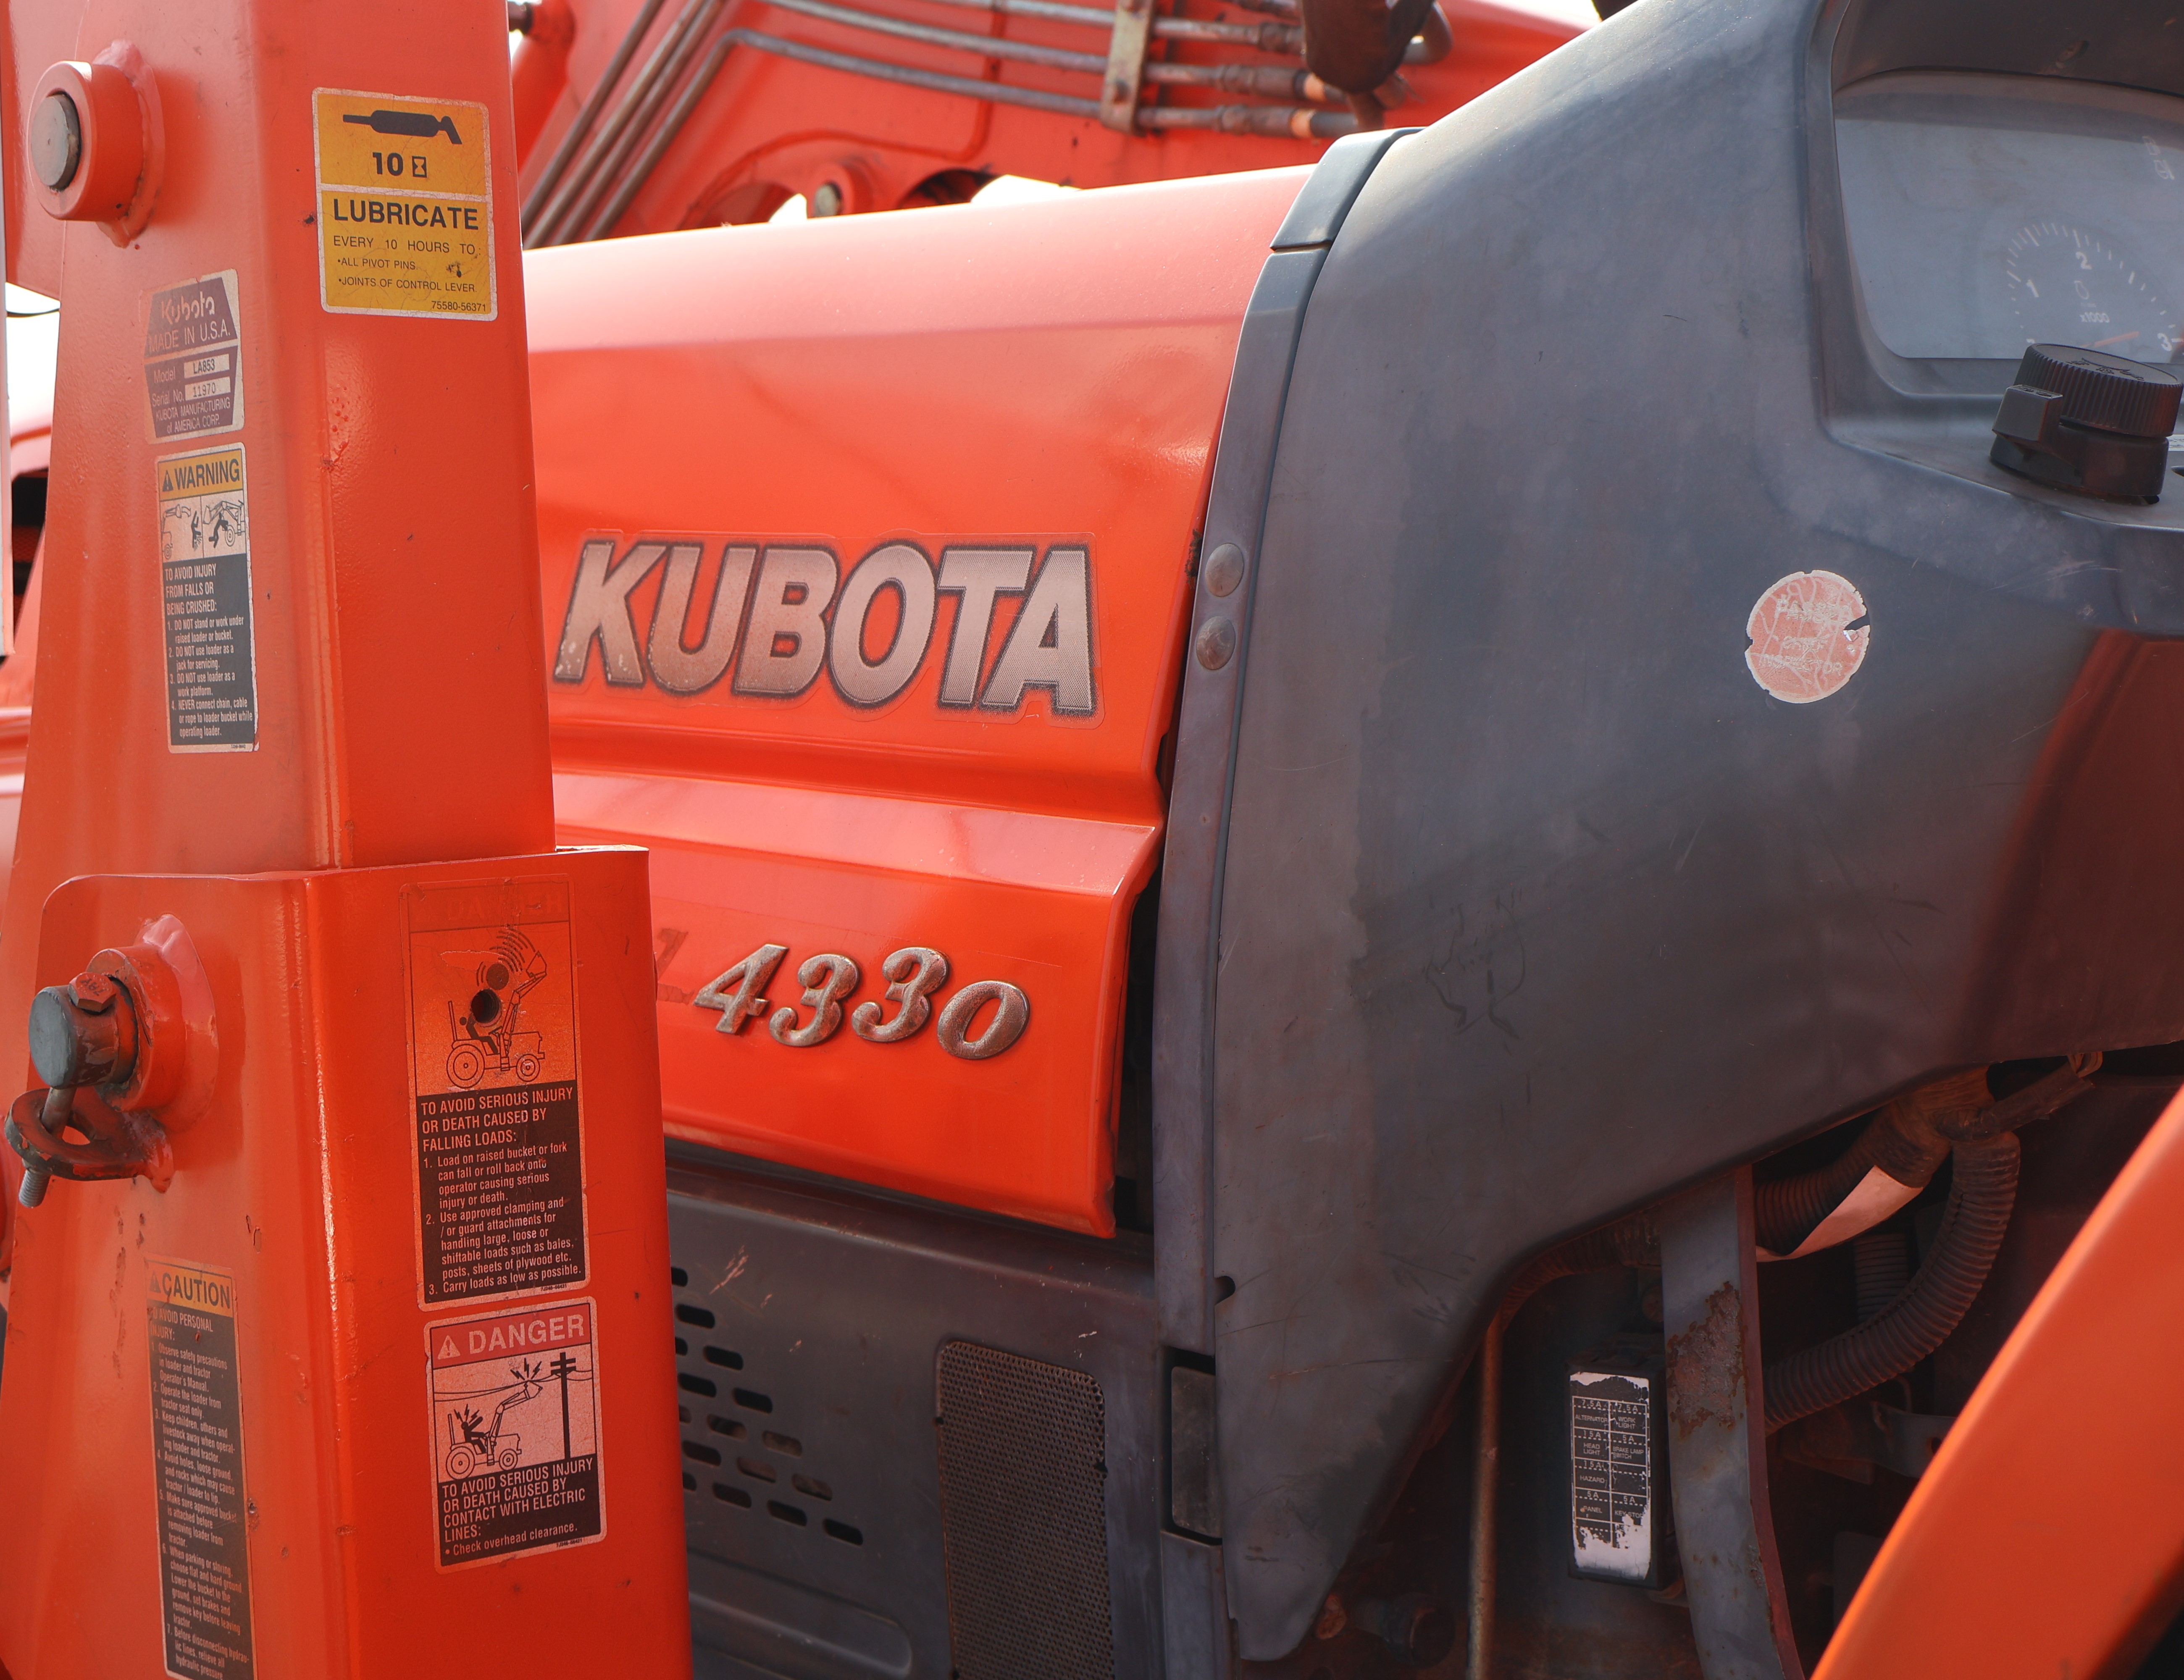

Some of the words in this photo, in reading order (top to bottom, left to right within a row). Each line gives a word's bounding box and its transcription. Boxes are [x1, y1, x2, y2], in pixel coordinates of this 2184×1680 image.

[373, 152, 403, 176] 10
[334, 199, 478, 230] LUBRICATE
[334, 236, 373, 247] EVERY
[385, 240, 397, 249] 10
[408, 241, 450, 252] HOURS
[363, 259, 390, 268] PIVOT
[394, 261, 418, 270] PINS.
[2076, 251, 2092, 270] 2
[342, 278, 376, 286] JOINTS
[381, 279, 393, 287] OF
[397, 280, 442, 291] CONTROL
[445, 283, 477, 292] LEVER.
[2026, 279, 2039, 297] 1
[161, 291, 215, 324] Kubota
[431, 301, 486, 312] 75580-56371
[149, 330, 179, 352] MADE
[184, 326, 194, 345] IN
[200, 319, 230, 341] U.S.A.
[2157, 333, 2172, 352] 3
[154, 367, 175, 383] Model
[193, 359, 215, 374] LA853
[152, 393, 170, 407] Serial
[173, 389, 184, 403] No.
[193, 383, 216, 397] 11970
[156, 407, 178, 421] KUBOTA
[181, 397, 230, 417] MANUFACTURING
[168, 422, 172, 433] of
[174, 418, 200, 433] AMERICA
[202, 414, 220, 427] CORP.
[174, 459, 239, 490] WARNING
[165, 568, 173, 581] TO
[175, 566, 192, 580] AVOID
[194, 563, 216, 578] INJURY
[166, 585, 183, 598] FROM
[185, 583, 203, 597] FALLS
[205, 582, 214, 594] OR
[167, 602, 184, 615] BEING
[186, 599, 217, 614] CRUSHED:
[175, 620, 181, 630] DO
[183, 619, 193, 630] NOT
[194, 617, 208, 629] stand
[216, 616, 228, 627] work
[229, 615, 244, 626] under
[552, 536, 1099, 718] KUBOTA
[175, 633, 190, 643] raised
[192, 632, 207, 643] loader
[215, 630, 233, 640] bucket.
[693, 943, 1031, 1061] 4330
[421, 1102, 436, 1116] TO
[440, 1097, 475, 1113] AVOID
[479, 1092, 528, 1109] SERIOUS
[533, 1087, 573, 1104] INJURY
[422, 1121, 439, 1134] OR
[443, 1115, 479, 1131] DEATH
[484, 1110, 528, 1127] CAUSED
[533, 1108, 547, 1121] BY
[423, 1135, 471, 1152] FALLING
[475, 1129, 516, 1146] LOADS:
[423, 1158, 432, 1168] 1.
[438, 1155, 460, 1167] Load
[463, 1155, 473, 1164] on
[477, 1149, 504, 1161] raised
[507, 1145, 536, 1159] bucket
[539, 1145, 548, 1154] or
[550, 1142, 567, 1154] fork
[438, 1171, 454, 1181] can
[457, 1167, 471, 1179] fall
[475, 1168, 484, 1177] or
[487, 1163, 501, 1175] roll
[505, 1161, 525, 1173] back
[528, 1159, 547, 1170] onto
[439, 1181, 477, 1197] operator
[480, 1177, 514, 1189] causing
[517, 1173, 549, 1186] serious
[426, 1215, 434, 1225] 2.
[440, 1212, 457, 1223] Use
[460, 1205, 501, 1222] approved
[505, 1200, 545, 1214] clamping
[548, 1197, 564, 1209] and
[439, 1198, 465, 1210] injury
[468, 1196, 477, 1205] or
[480, 1191, 508, 1204] death.
[447, 1227, 455, 1236] or
[459, 1222, 484, 1236] guard
[487, 1214, 541, 1231] attachments
[544, 1213, 556, 1223] for
[442, 1237, 480, 1251] handling
[484, 1234, 509, 1246] large,
[513, 1230, 536, 1241] loose
[540, 1228, 548, 1237] or
[442, 1250, 481, 1265] shiftable
[484, 1247, 508, 1259] loads
[511, 1244, 531, 1255] such
[534, 1243, 544, 1251] as
[547, 1238, 574, 1250] bales,
[443, 1267, 470, 1281] posts,
[473, 1262, 502, 1274] sheets
[505, 1259, 513, 1270] of
[516, 1252, 552, 1270] plywood
[555, 1252, 571, 1263] etc.
[162, 1273, 230, 1309] CAUTION
[429, 1284, 437, 1295] 3.
[443, 1281, 467, 1293] Carry
[470, 1277, 494, 1289] loads
[497, 1276, 507, 1285] as
[510, 1272, 526, 1283] low
[528, 1272, 539, 1280] as
[541, 1265, 581, 1281] possible.
[160, 1309, 178, 1324] AVOID
[180, 1313, 213, 1332] PERSONAL
[469, 1314, 585, 1354] DANGER
[1575, 1414, 1608, 1423] ALTERNATOR
[443, 1483, 457, 1498] TO
[462, 1477, 495, 1494] AVOID
[500, 1466, 549, 1487] SERIOUS
[553, 1458, 593, 1477] INJURY
[444, 1499, 459, 1513] OR
[464, 1490, 500, 1509] DEATH
[504, 1481, 549, 1501] CAUSED
[553, 1477, 567, 1491] BY
[444, 1505, 496, 1528] CONTACT
[500, 1499, 529, 1517] WITH
[534, 1488, 585, 1510] ELECTRIC
[445, 1524, 481, 1543] LINES:
[454, 1541, 481, 1555] Check
[484, 1530, 526, 1549] overhead
[530, 1523, 577, 1539] clearance.
